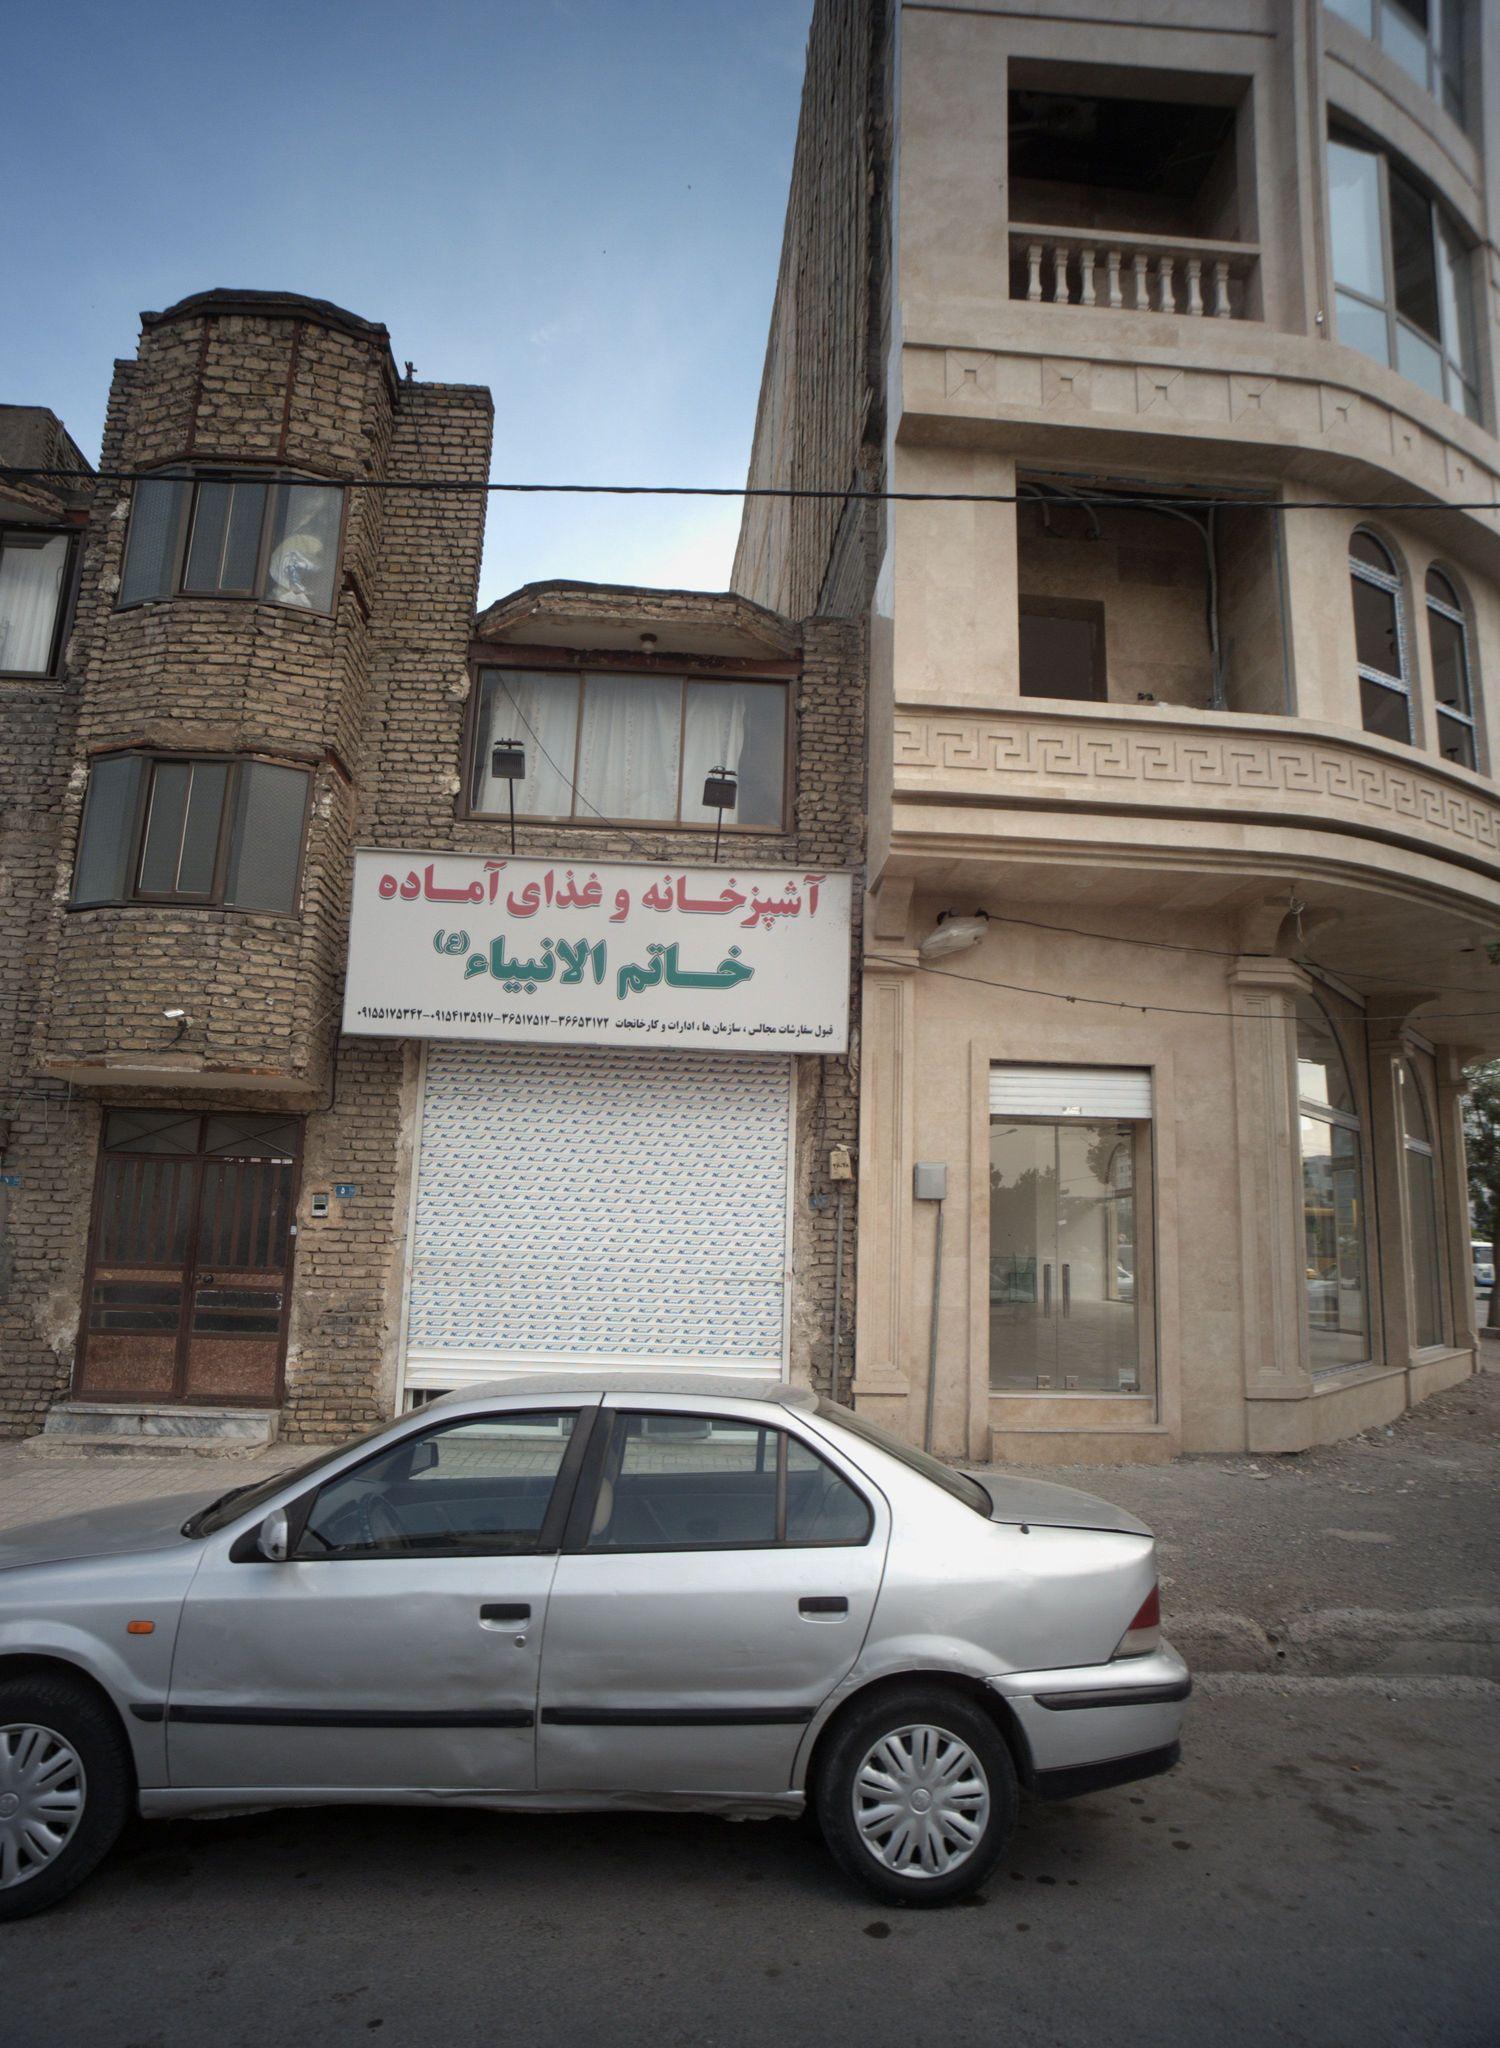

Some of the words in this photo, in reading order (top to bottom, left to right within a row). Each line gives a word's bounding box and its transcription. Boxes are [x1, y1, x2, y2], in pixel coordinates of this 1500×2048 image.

[378, 860, 507, 906] آماده
[506, 869, 603, 919] غذای
[641, 874, 827, 931] آشپزخانه
[609, 888, 631, 923] و
[616, 942, 755, 1000] خاتم
[615, 1018, 659, 1033] کارخانجات
[779, 1023, 813, 1037] سفارشات
[815, 1024, 834, 1038] قبول
